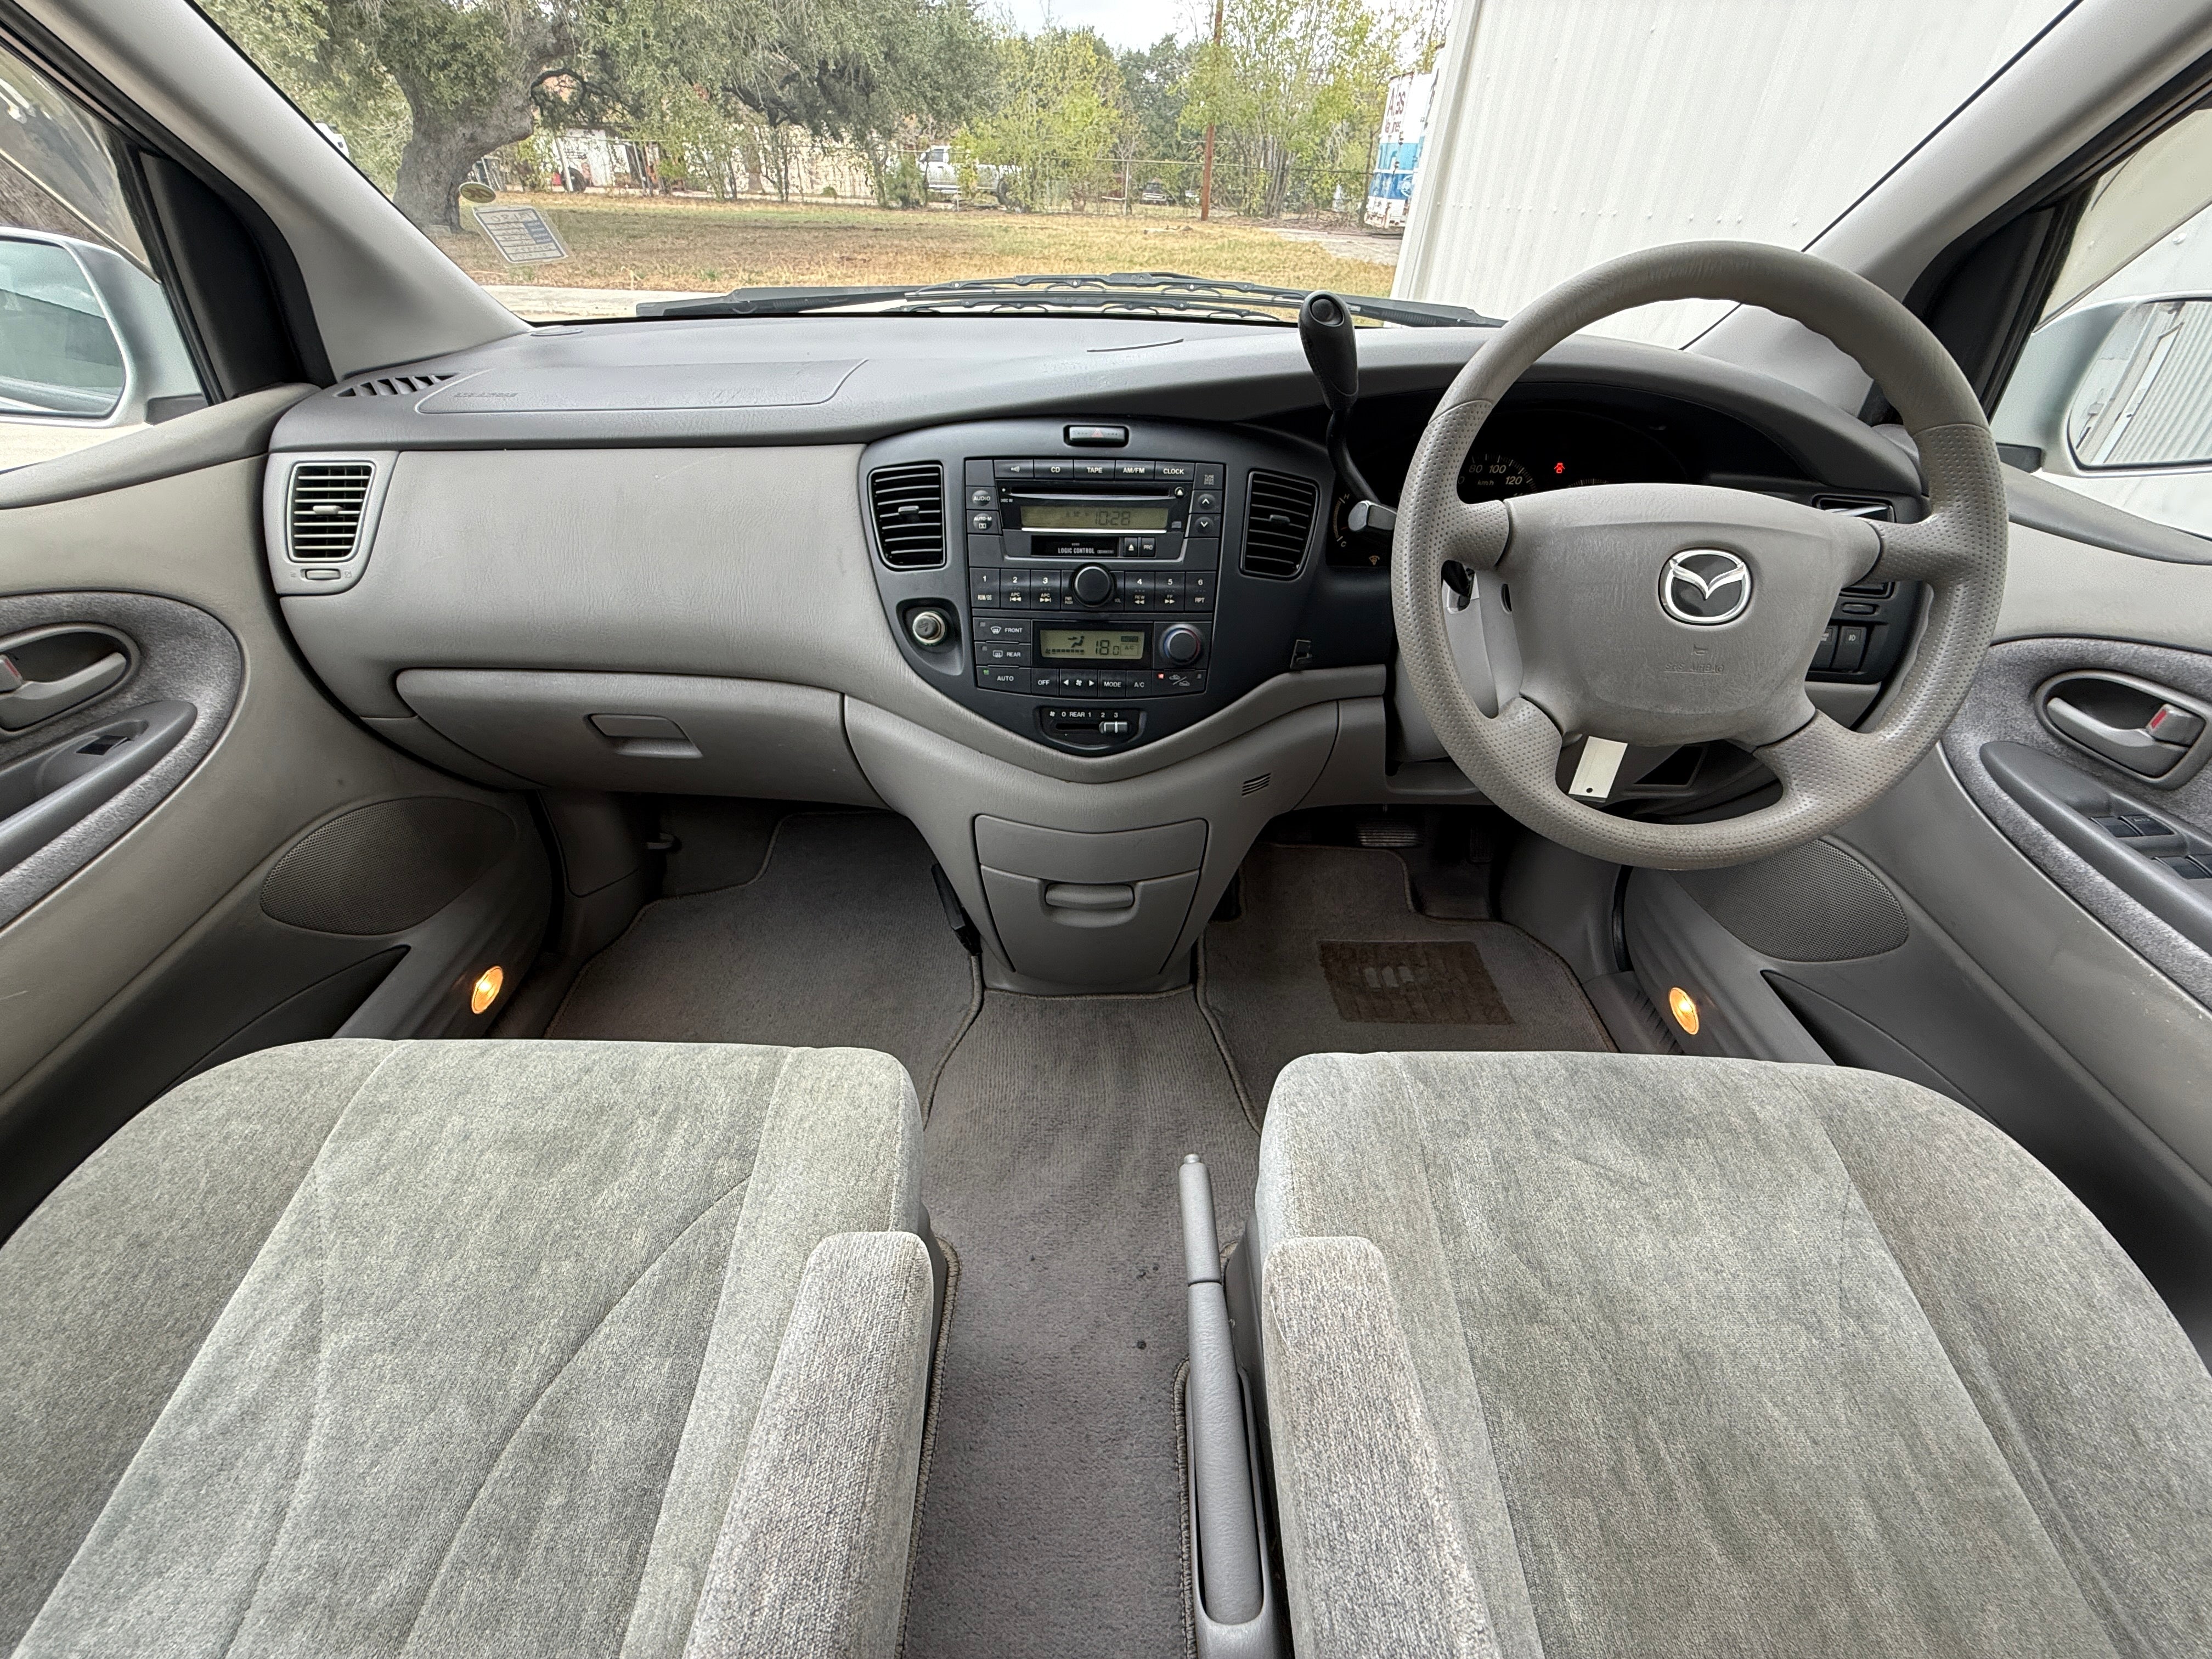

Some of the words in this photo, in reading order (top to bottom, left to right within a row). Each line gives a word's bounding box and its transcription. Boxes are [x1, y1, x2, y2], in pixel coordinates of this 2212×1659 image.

[1469, 464, 1483, 473] 80
[1489, 465, 1506, 473] 100
[1505, 476, 1522, 485] 120
[1665, 662, 1685, 671] SRS
[1690, 663, 1724, 674] AIRBAG
